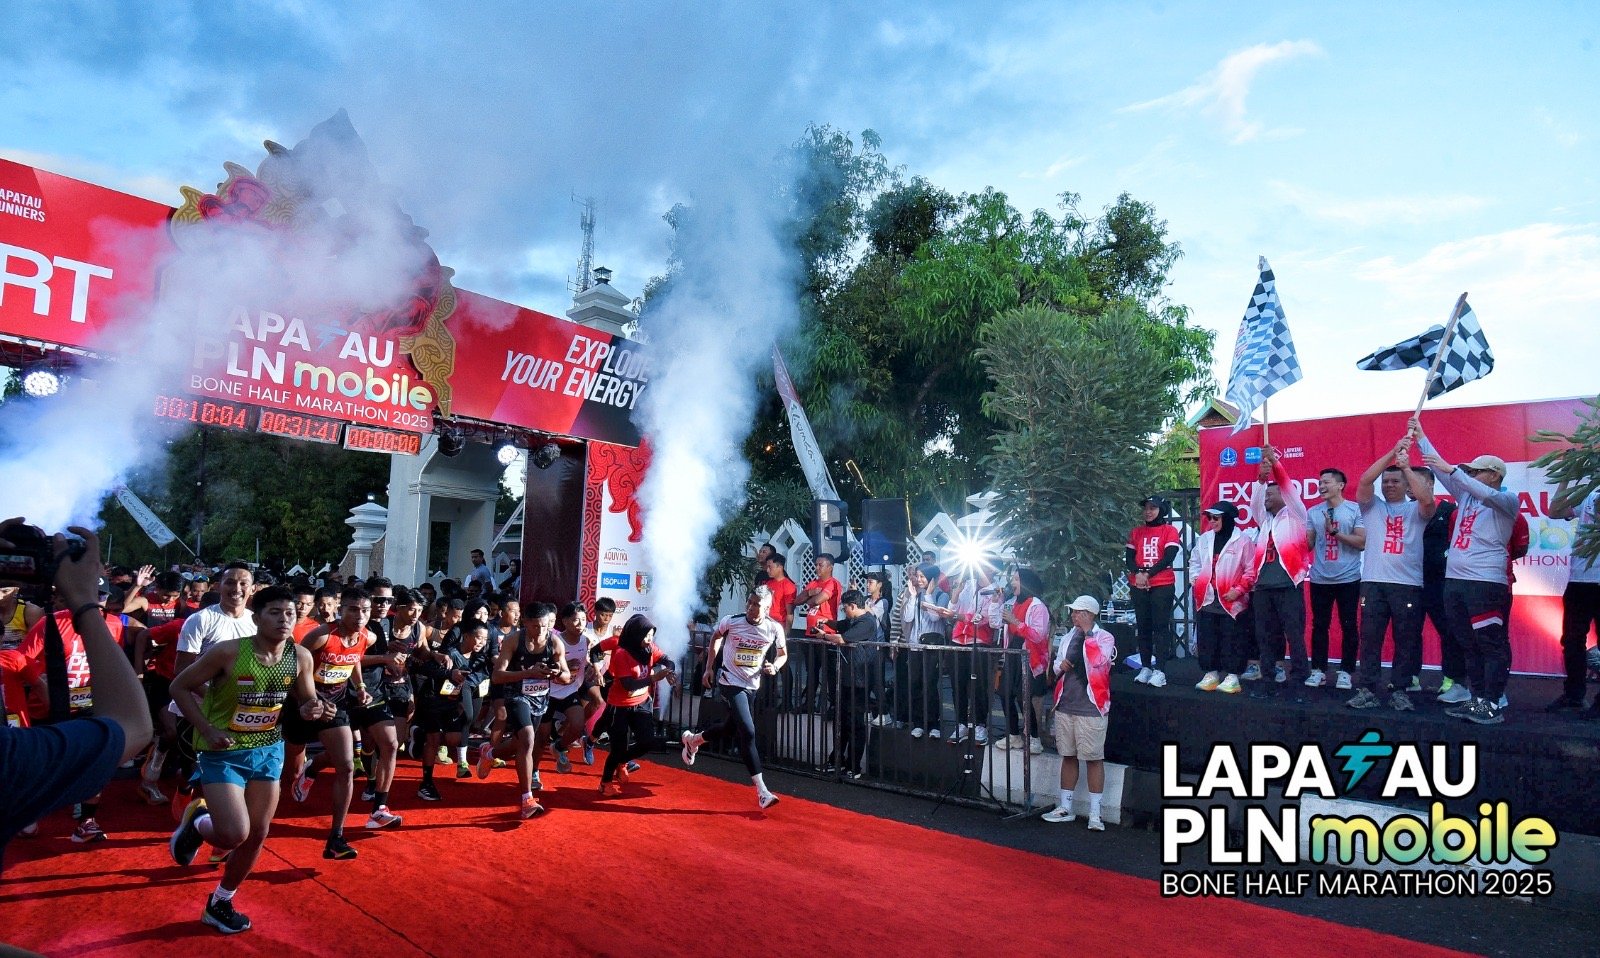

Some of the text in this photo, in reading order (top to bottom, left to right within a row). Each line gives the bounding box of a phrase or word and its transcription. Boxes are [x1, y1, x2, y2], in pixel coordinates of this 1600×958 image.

[0, 188, 42, 209] APATAU
[0, 204, 46, 223] UNNERS
[0, 242, 114, 324] RT
[564, 334, 649, 383] EXPLODE
[293, 360, 433, 411] mobile
[500, 350, 646, 411] YOUR ENERGY
[190, 374, 429, 429] BONE HALF MARATHON 2025
[260, 411, 339, 442] 00:31:41
[347, 428, 420, 453] 00:00:00
[1512, 555, 1568, 567] ATHON
[235, 713, 277, 724] 50506
